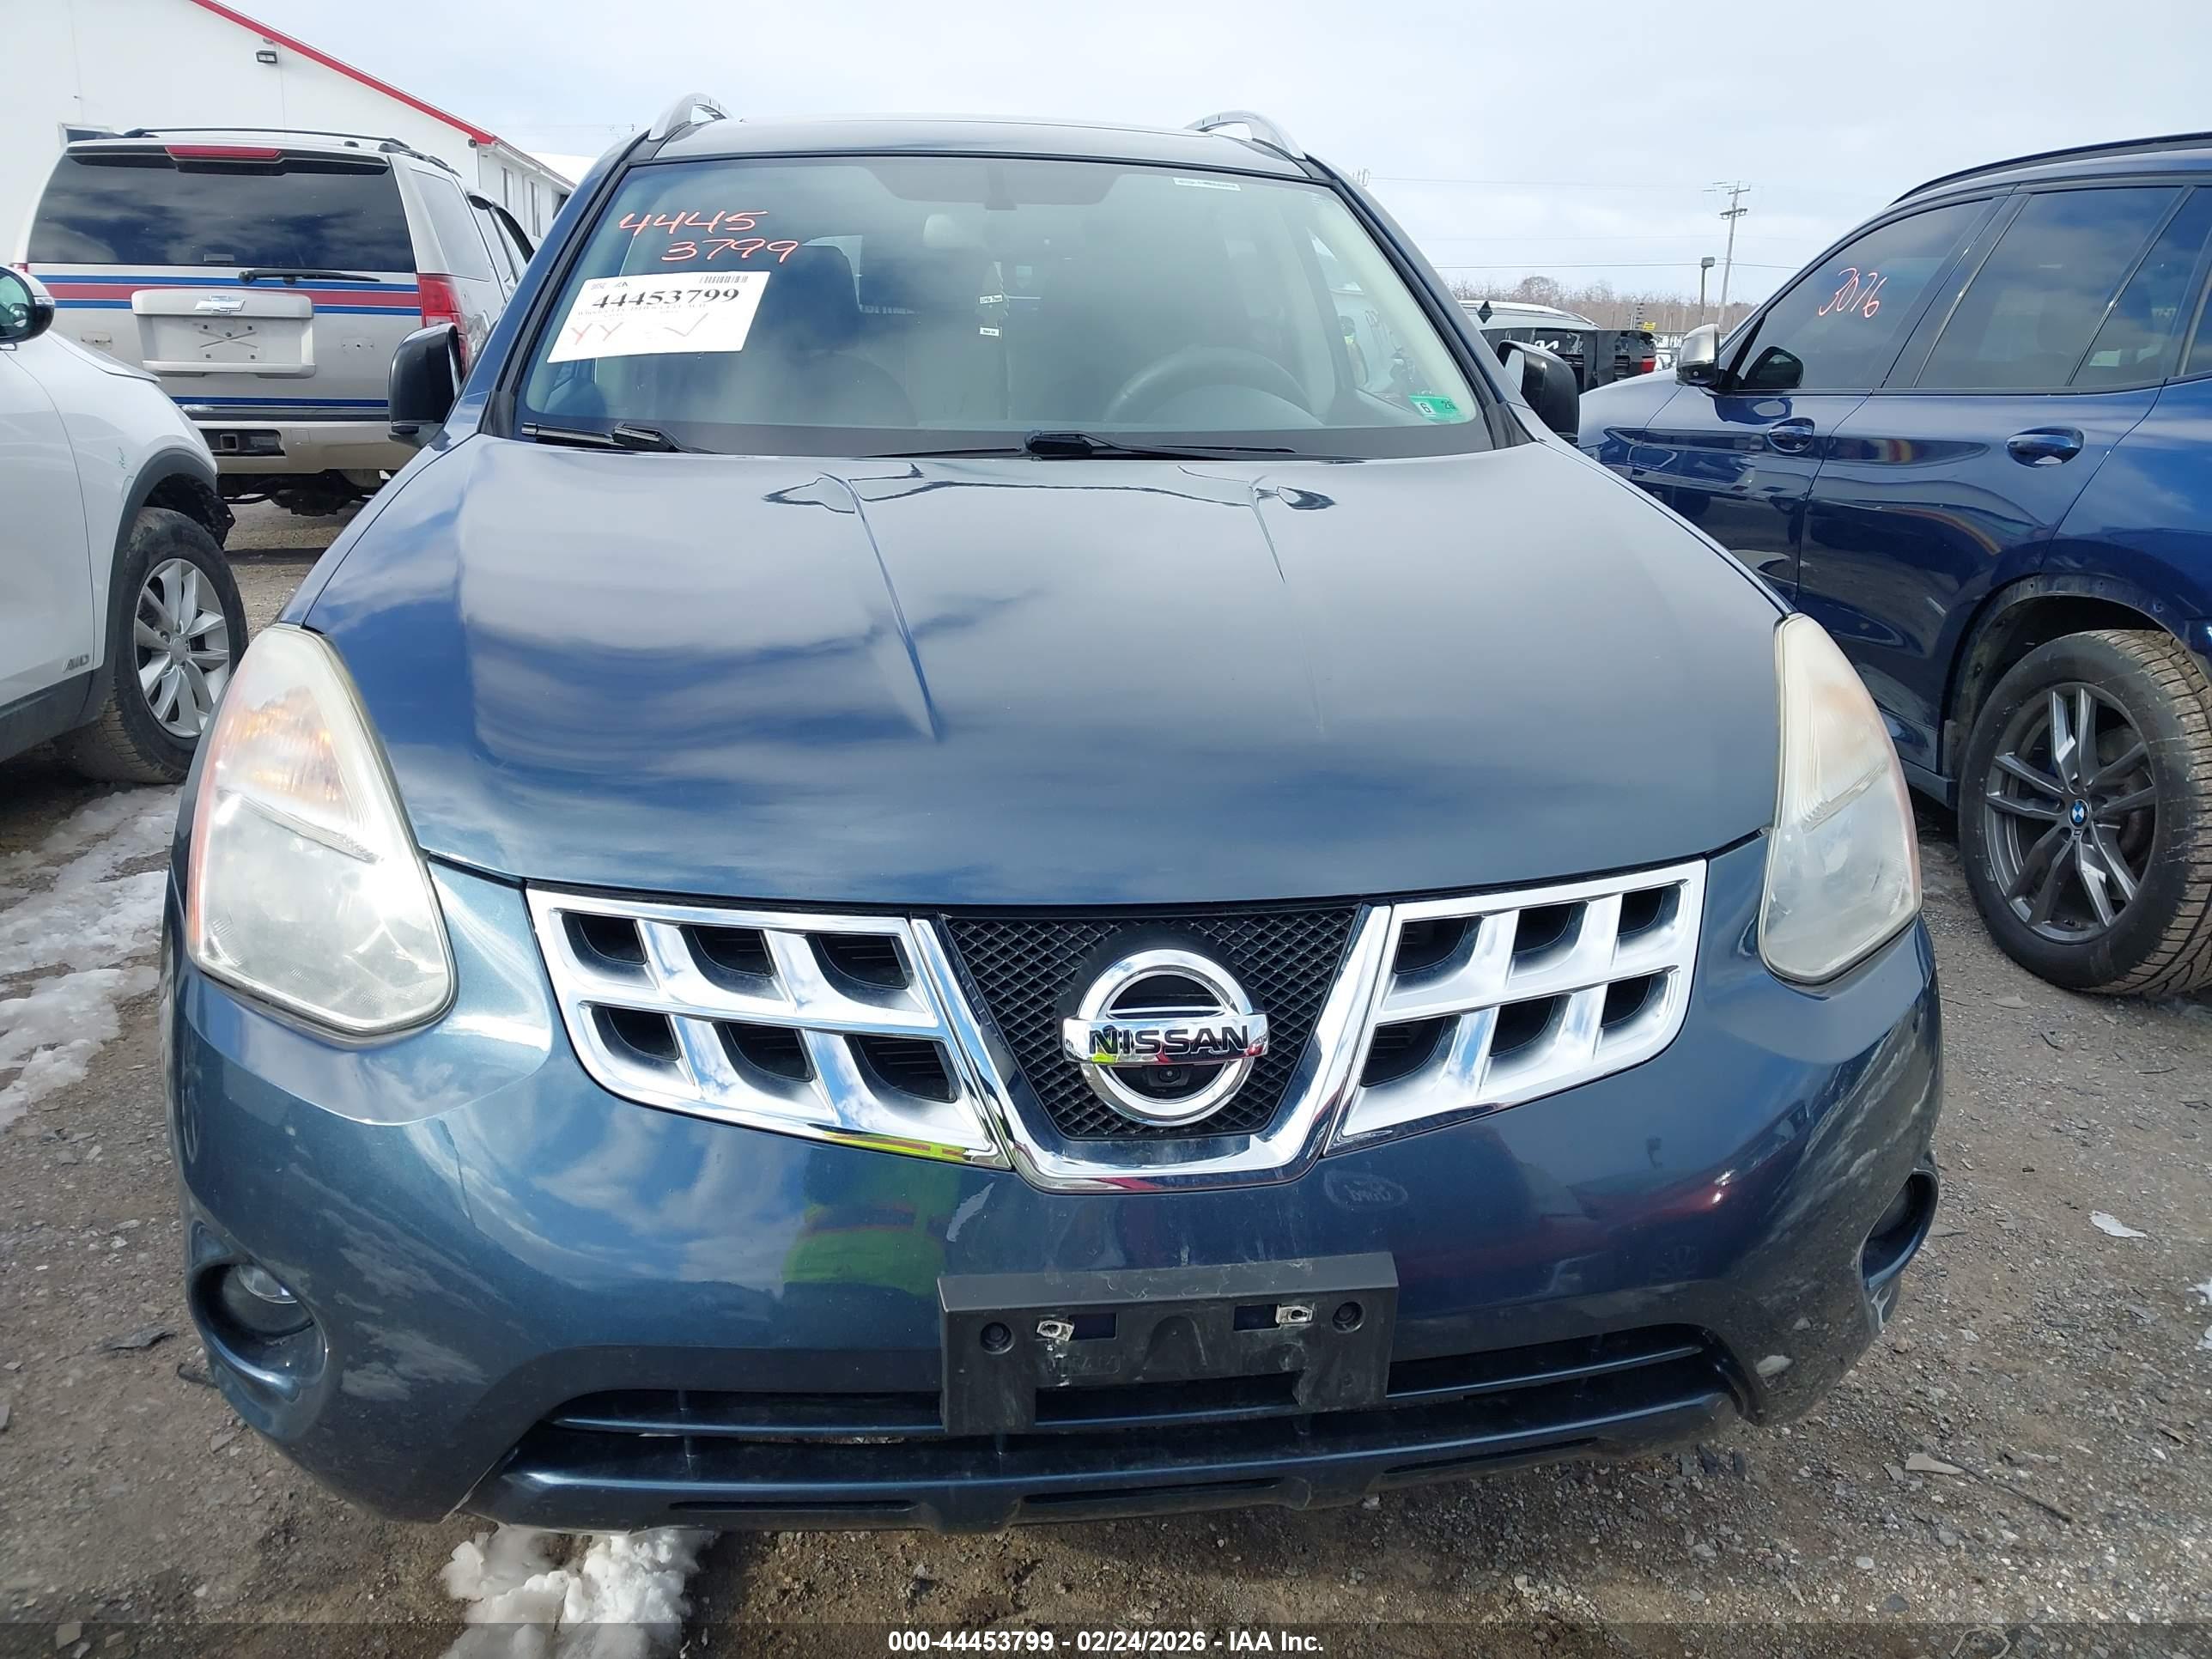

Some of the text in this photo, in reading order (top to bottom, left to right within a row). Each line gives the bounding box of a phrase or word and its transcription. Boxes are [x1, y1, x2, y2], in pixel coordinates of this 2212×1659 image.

[619, 211, 769, 235] 4445
[661, 238, 799, 263] 3799
[592, 288, 739, 308] 44453799
[1089, 1025, 1249, 1055] NISSAN
